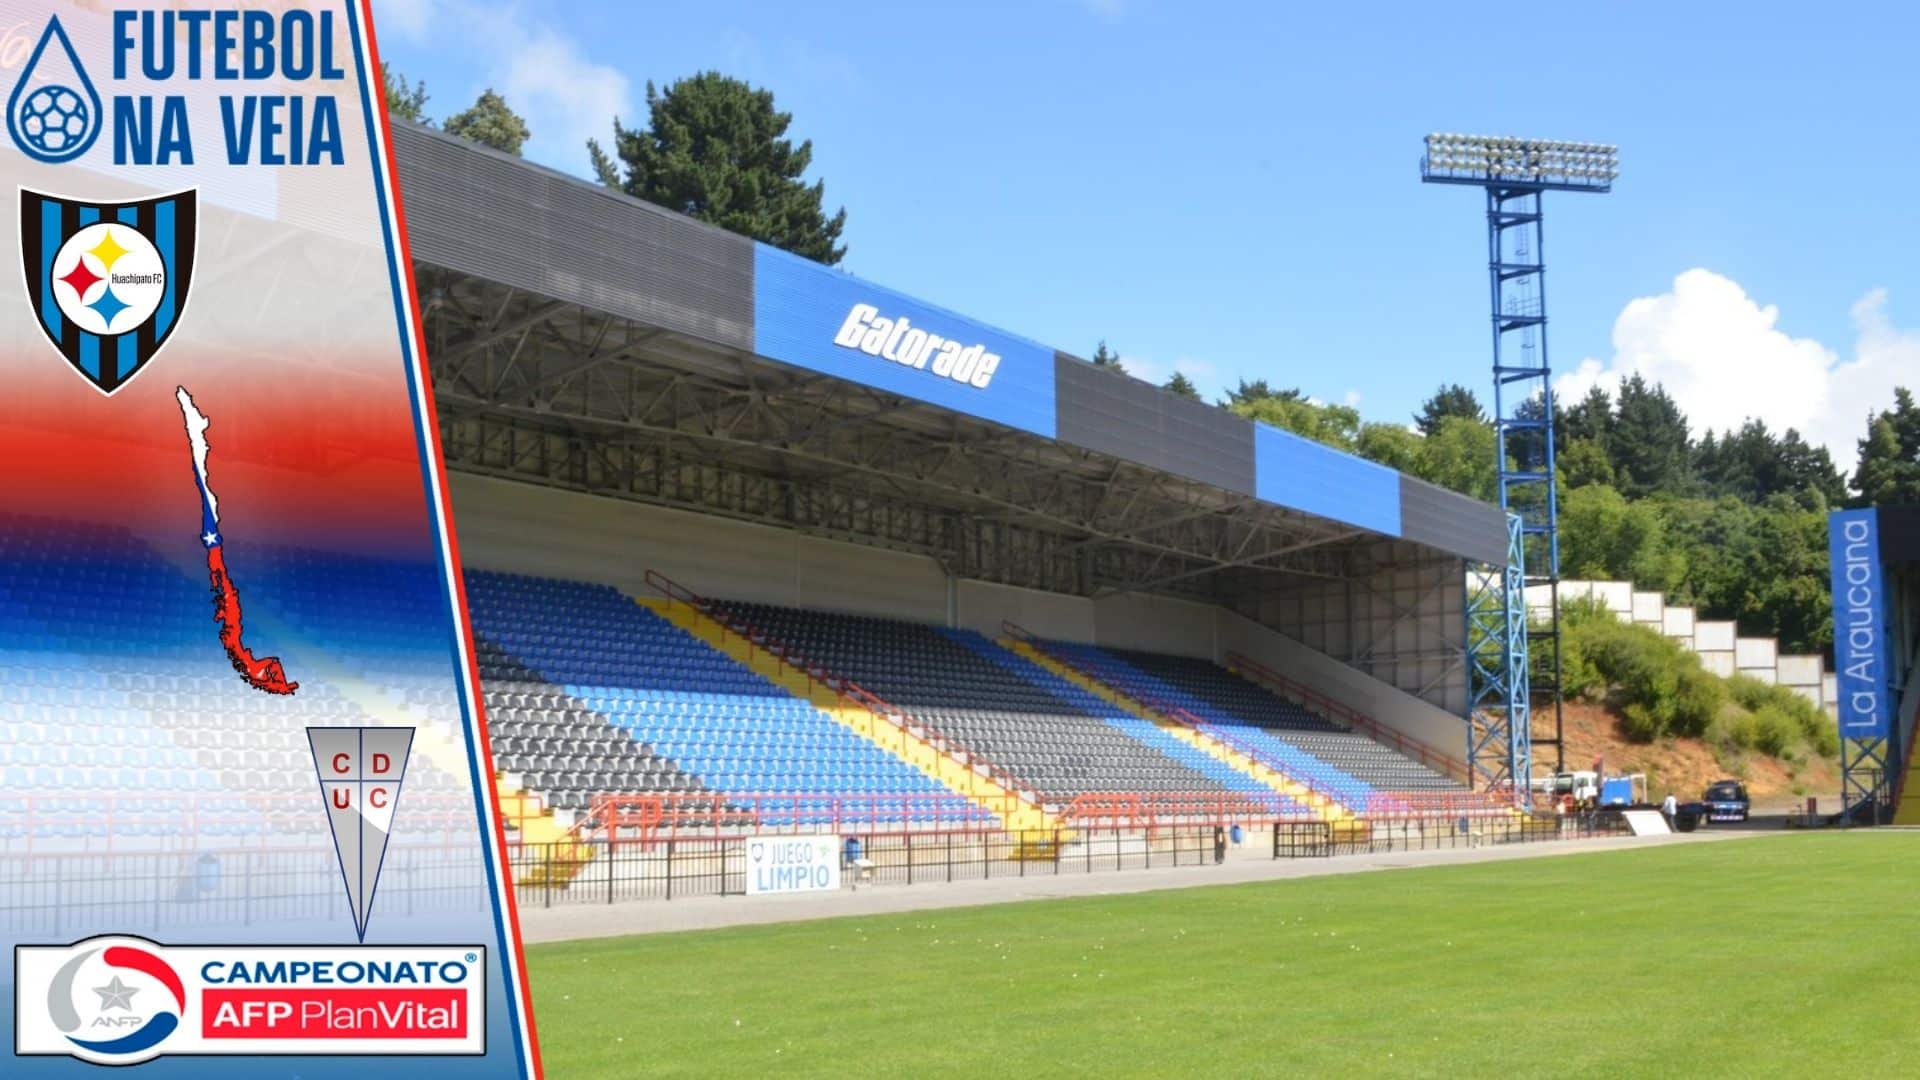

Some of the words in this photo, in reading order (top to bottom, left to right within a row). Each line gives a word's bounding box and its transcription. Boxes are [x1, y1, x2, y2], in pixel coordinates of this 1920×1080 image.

[834, 303, 1001, 389] Gatorade
[1844, 519, 1875, 682] Araucana
[1847, 691, 1877, 727] La
[771, 842, 813, 865] JUEGO
[757, 865, 830, 891] LIMPIO
